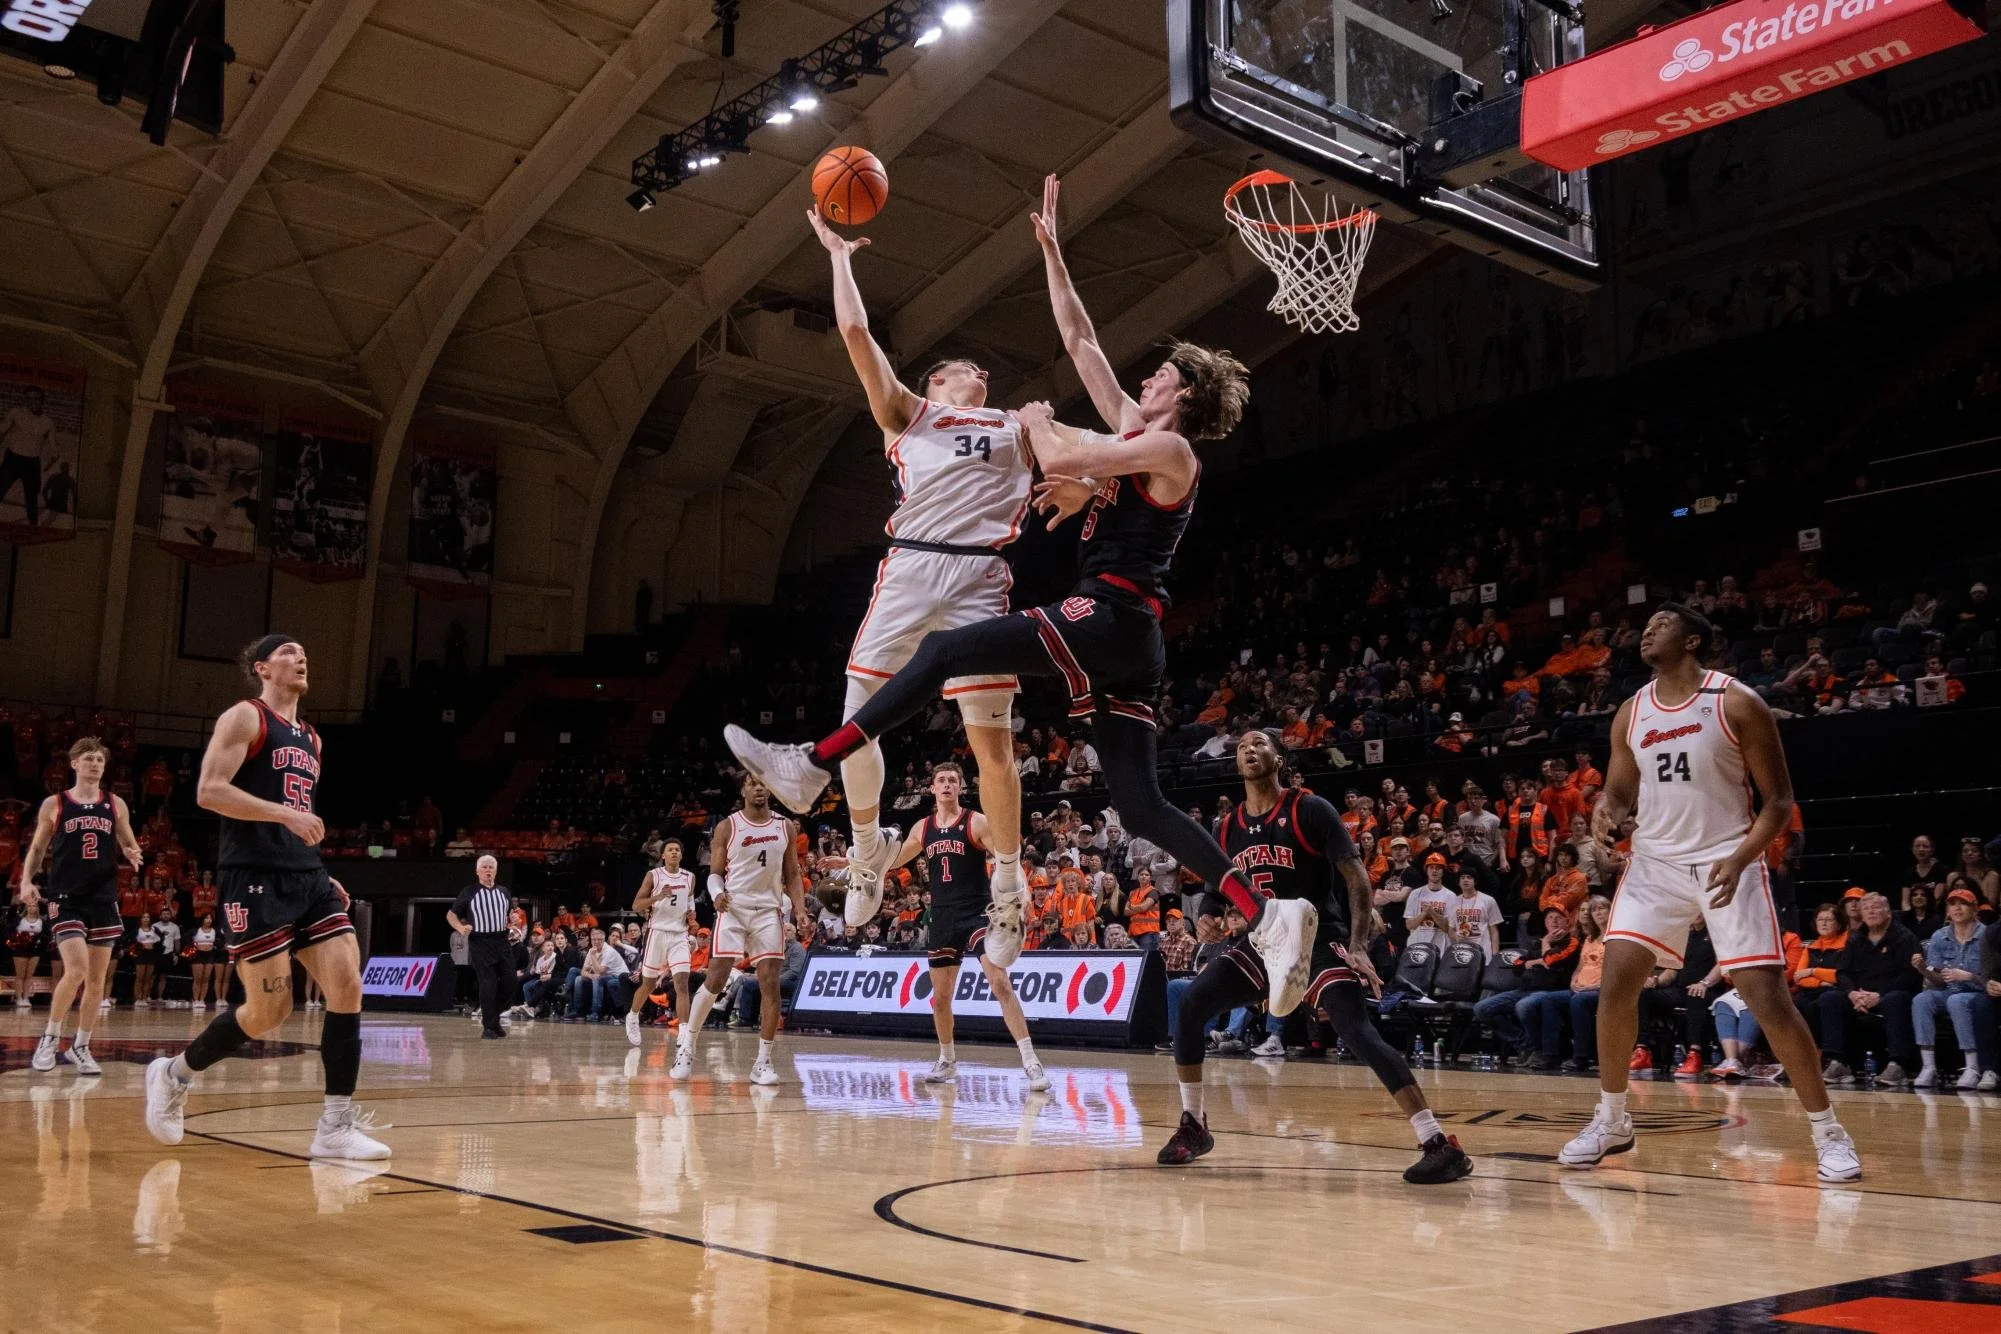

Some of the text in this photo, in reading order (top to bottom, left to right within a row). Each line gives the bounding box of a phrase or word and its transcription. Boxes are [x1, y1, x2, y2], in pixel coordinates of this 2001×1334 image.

[933, 415, 1005, 430] Beavers
[955, 435, 992, 463] 34
[1640, 722, 1703, 749] Beavers
[272, 746, 321, 784] UTAH
[1656, 751, 1691, 783] 24
[283, 773, 313, 813] 55
[65, 816, 113, 834] UTAH
[82, 832, 98, 859] 2
[757, 849, 767, 867] 4
[926, 839, 965, 859] UTAH
[1232, 844, 1296, 874] UTAH
[941, 856, 953, 882] 1
[670, 894, 678, 907] 2
[363, 966, 408, 986] BELFOR
[808, 970, 898, 999] BELFOR
